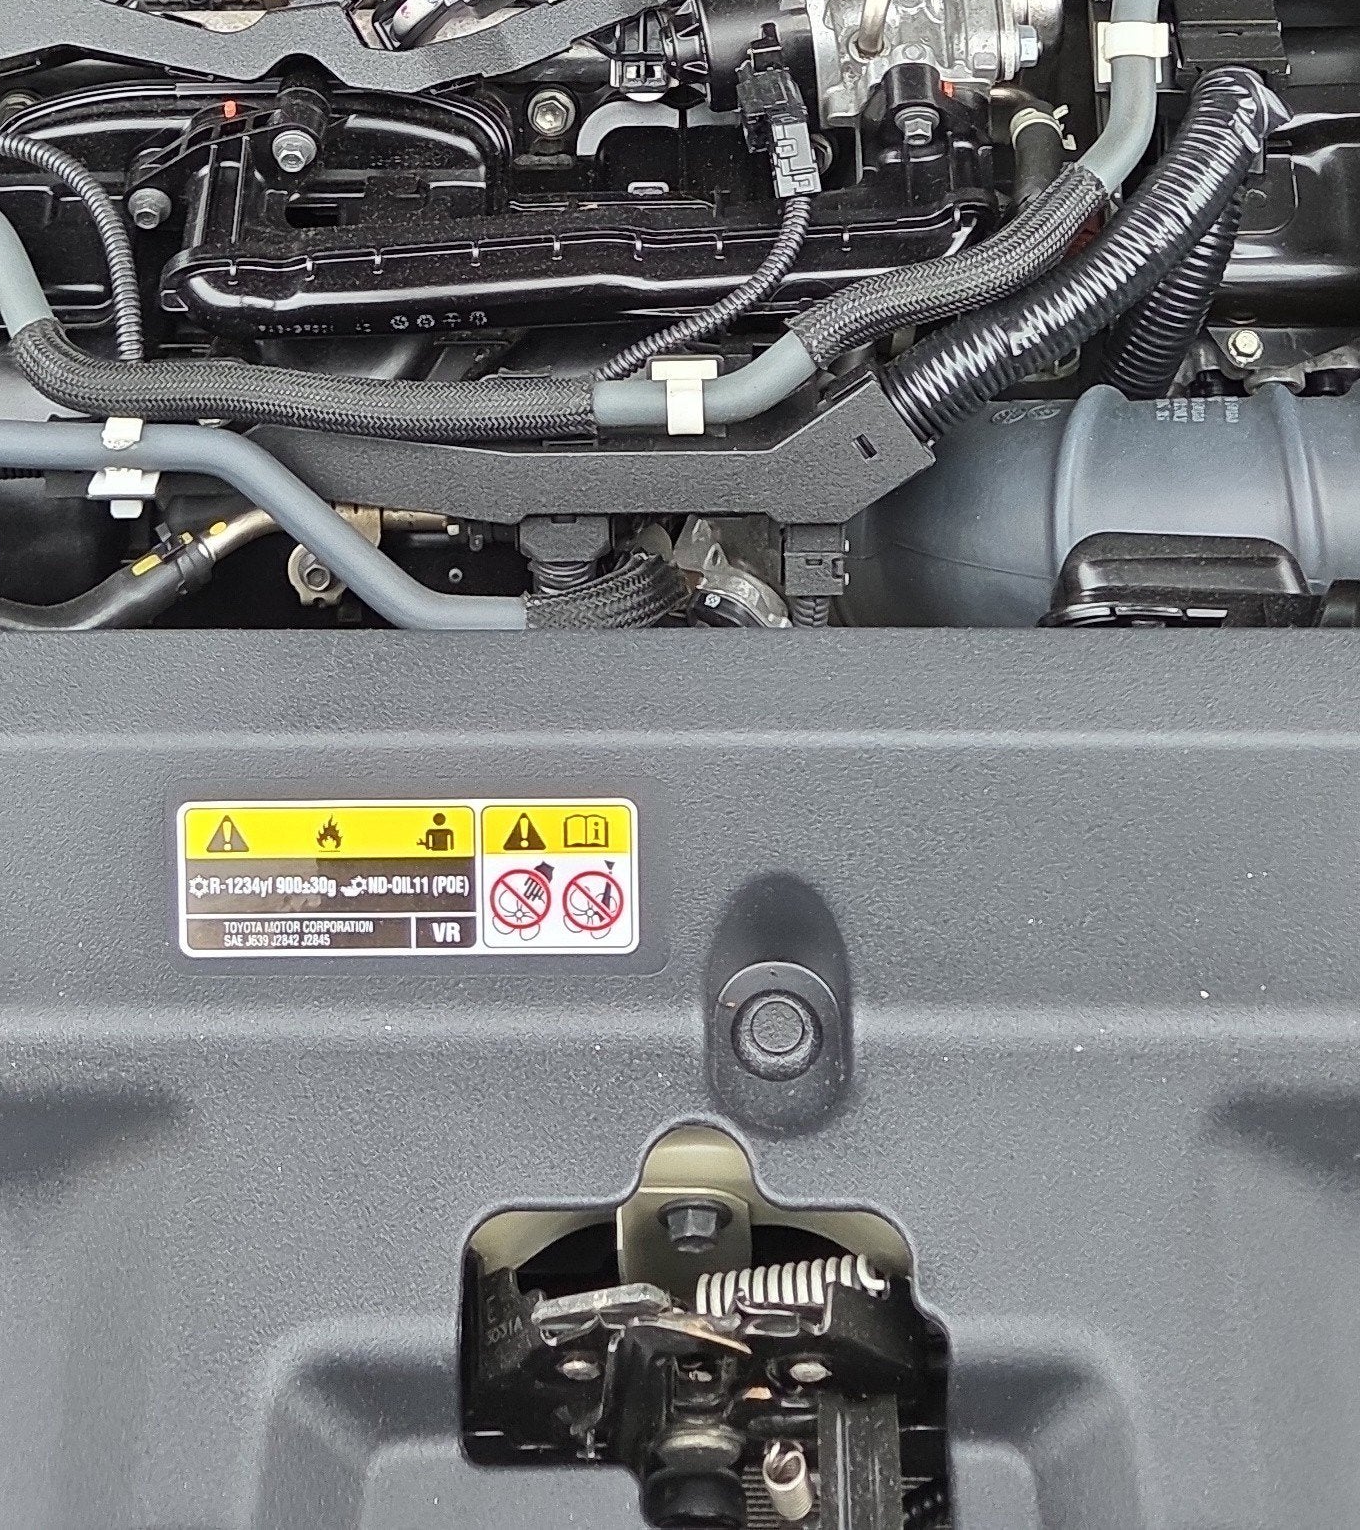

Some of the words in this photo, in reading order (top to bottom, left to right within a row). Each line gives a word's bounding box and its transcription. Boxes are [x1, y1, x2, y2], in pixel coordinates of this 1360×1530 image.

[209, 876, 273, 898] R-1234yf
[275, 876, 337, 898] 900±30g
[367, 876, 429, 895] ND-OIL11
[432, 875, 470, 898] (POE)
[224, 921, 261, 934] TOYOTA
[264, 921, 301, 934] MOTOR
[302, 920, 374, 934] CORPORATION
[431, 921, 462, 943] VR
[224, 934, 244, 947] SAE
[271, 933, 299, 947] J2842
